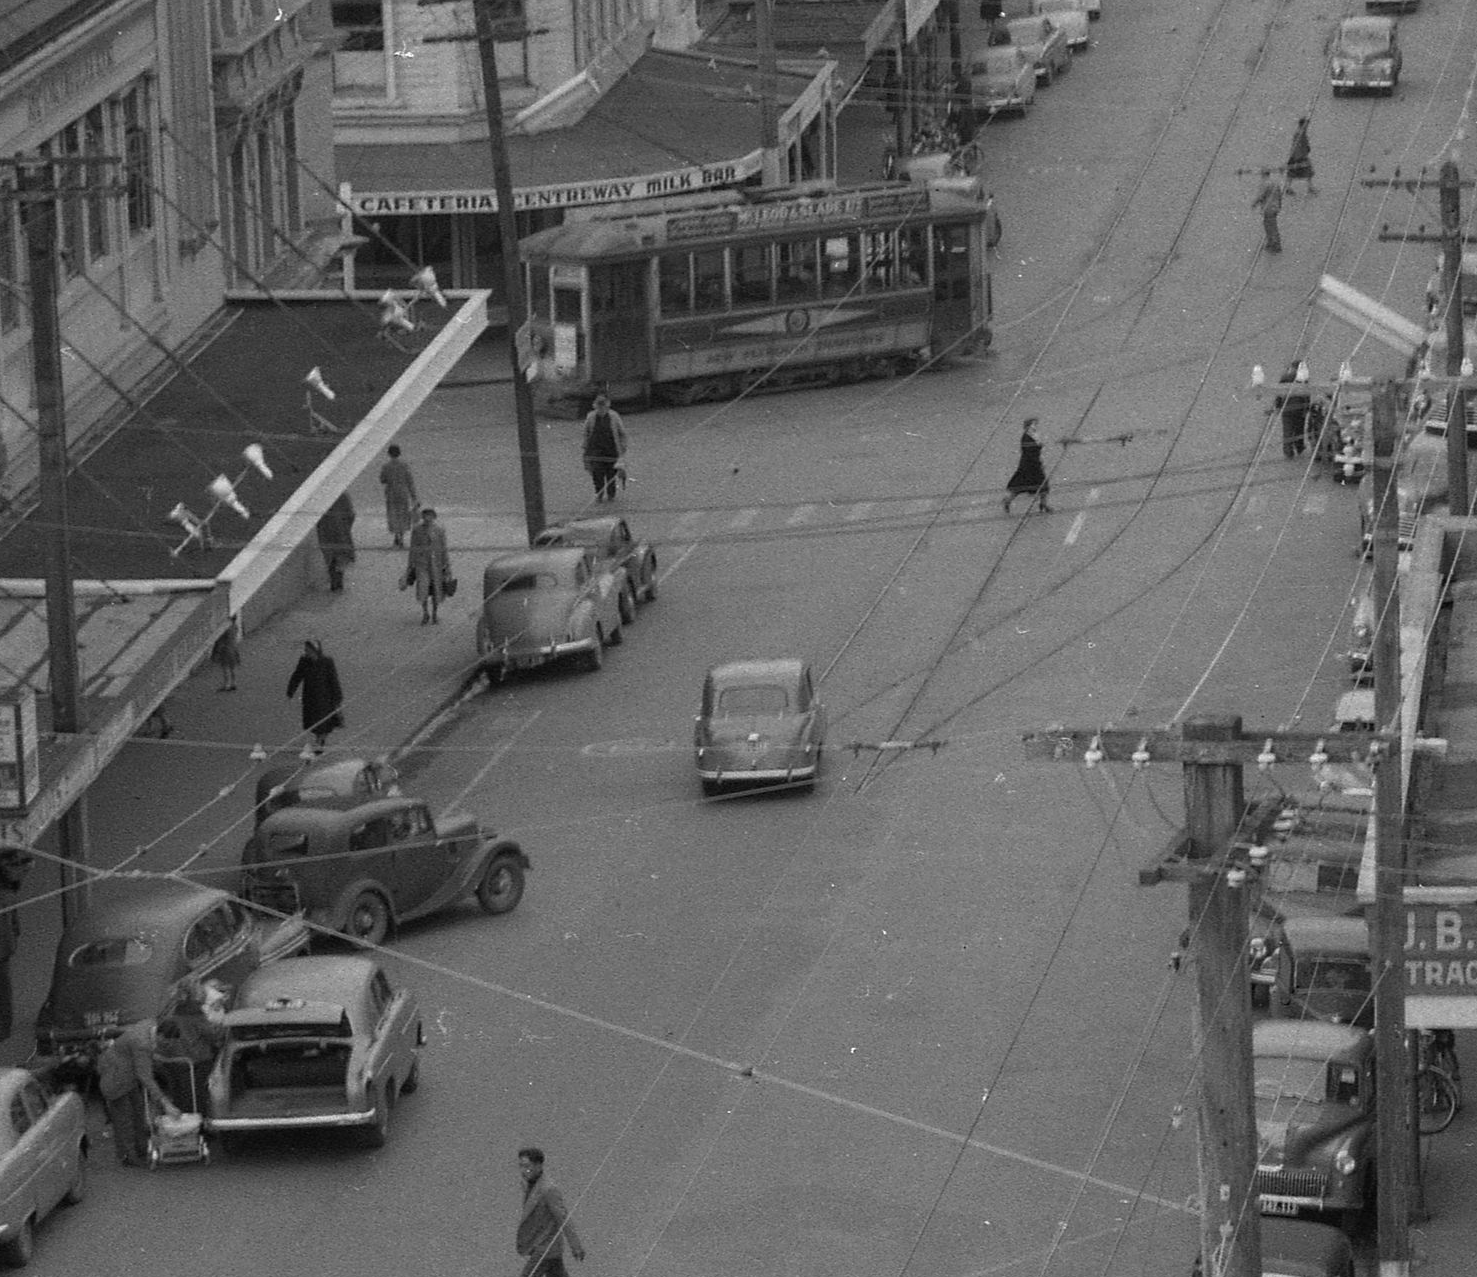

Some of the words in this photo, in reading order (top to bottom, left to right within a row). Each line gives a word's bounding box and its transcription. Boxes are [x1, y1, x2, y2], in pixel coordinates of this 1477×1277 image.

[359, 193, 497, 214] CAFETERIA
[645, 173, 692, 195] MILK
[701, 166, 737, 184] BAR
[1434, 911, 1476, 953] B.
